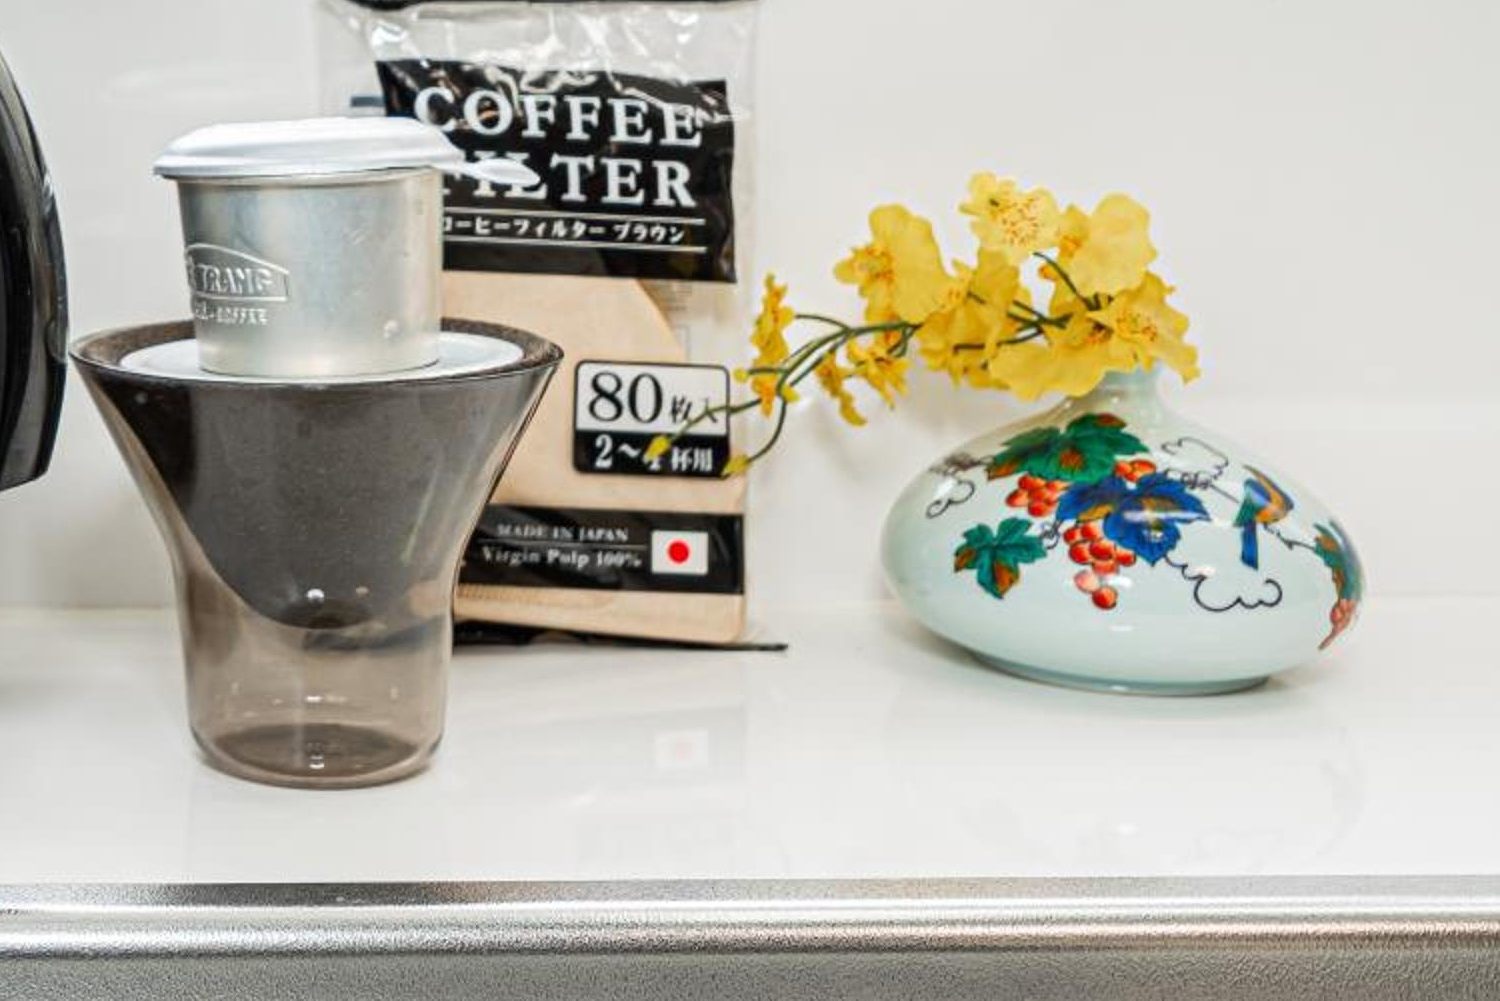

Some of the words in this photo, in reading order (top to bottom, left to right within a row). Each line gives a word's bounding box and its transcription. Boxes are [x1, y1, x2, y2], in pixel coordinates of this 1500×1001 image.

[414, 86, 703, 148] COFFEE
[443, 150, 697, 207] ILTER
[612, 222, 685, 243] ブラウン
[497, 523, 546, 538] MADE
[552, 526, 574, 540] IN
[579, 527, 629, 542] JAPAN
[481, 546, 541, 567] Virgin
[547, 549, 591, 570] Pulp
[596, 550, 643, 568] 100%
